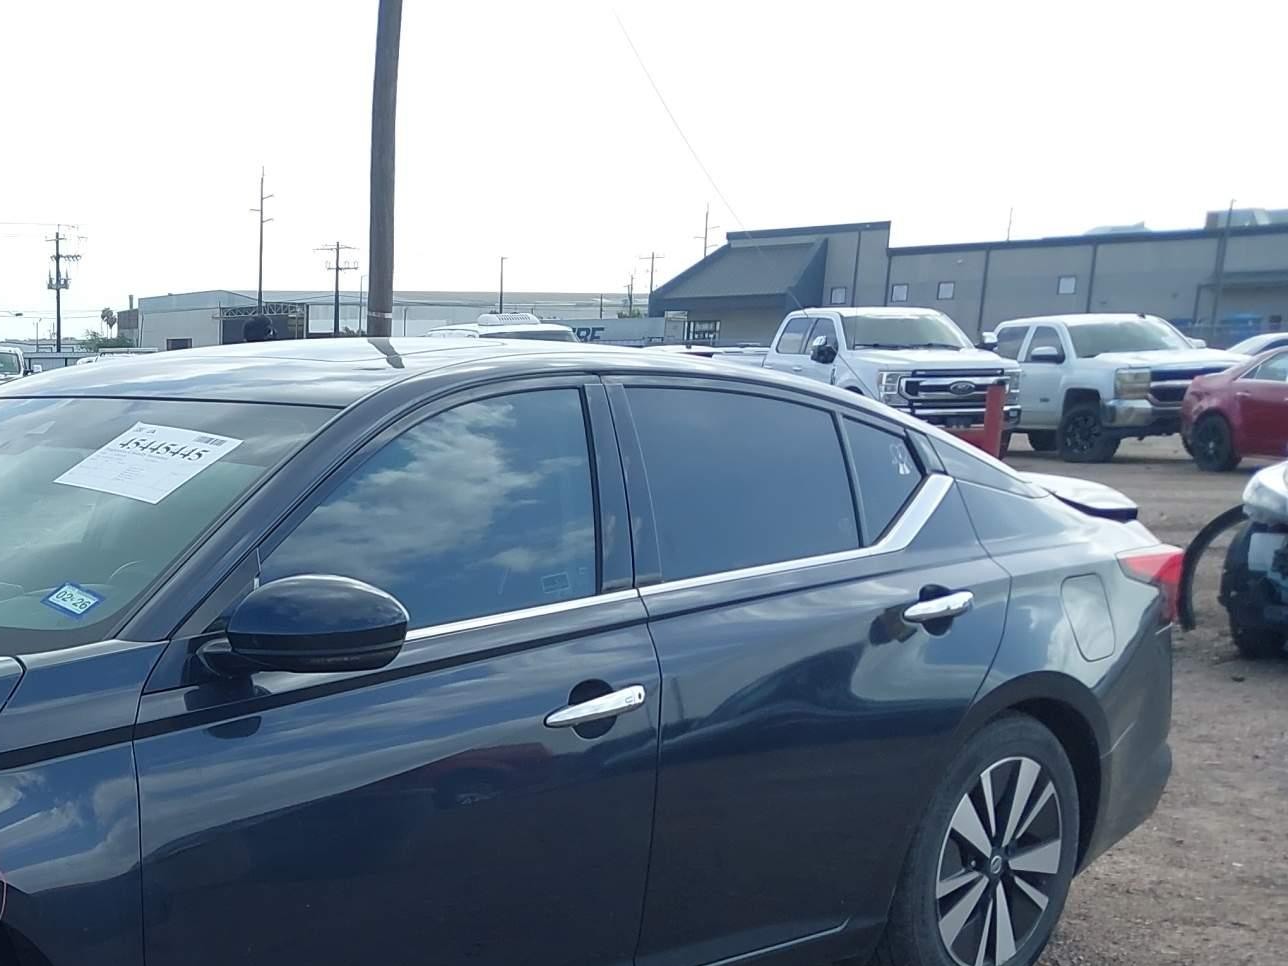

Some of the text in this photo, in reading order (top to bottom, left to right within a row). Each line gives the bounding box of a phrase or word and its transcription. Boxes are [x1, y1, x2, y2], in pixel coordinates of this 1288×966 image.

[572, 327, 605, 342] RE
[119, 437, 210, 461] 45445445
[55, 590, 91, 610] 02-26
